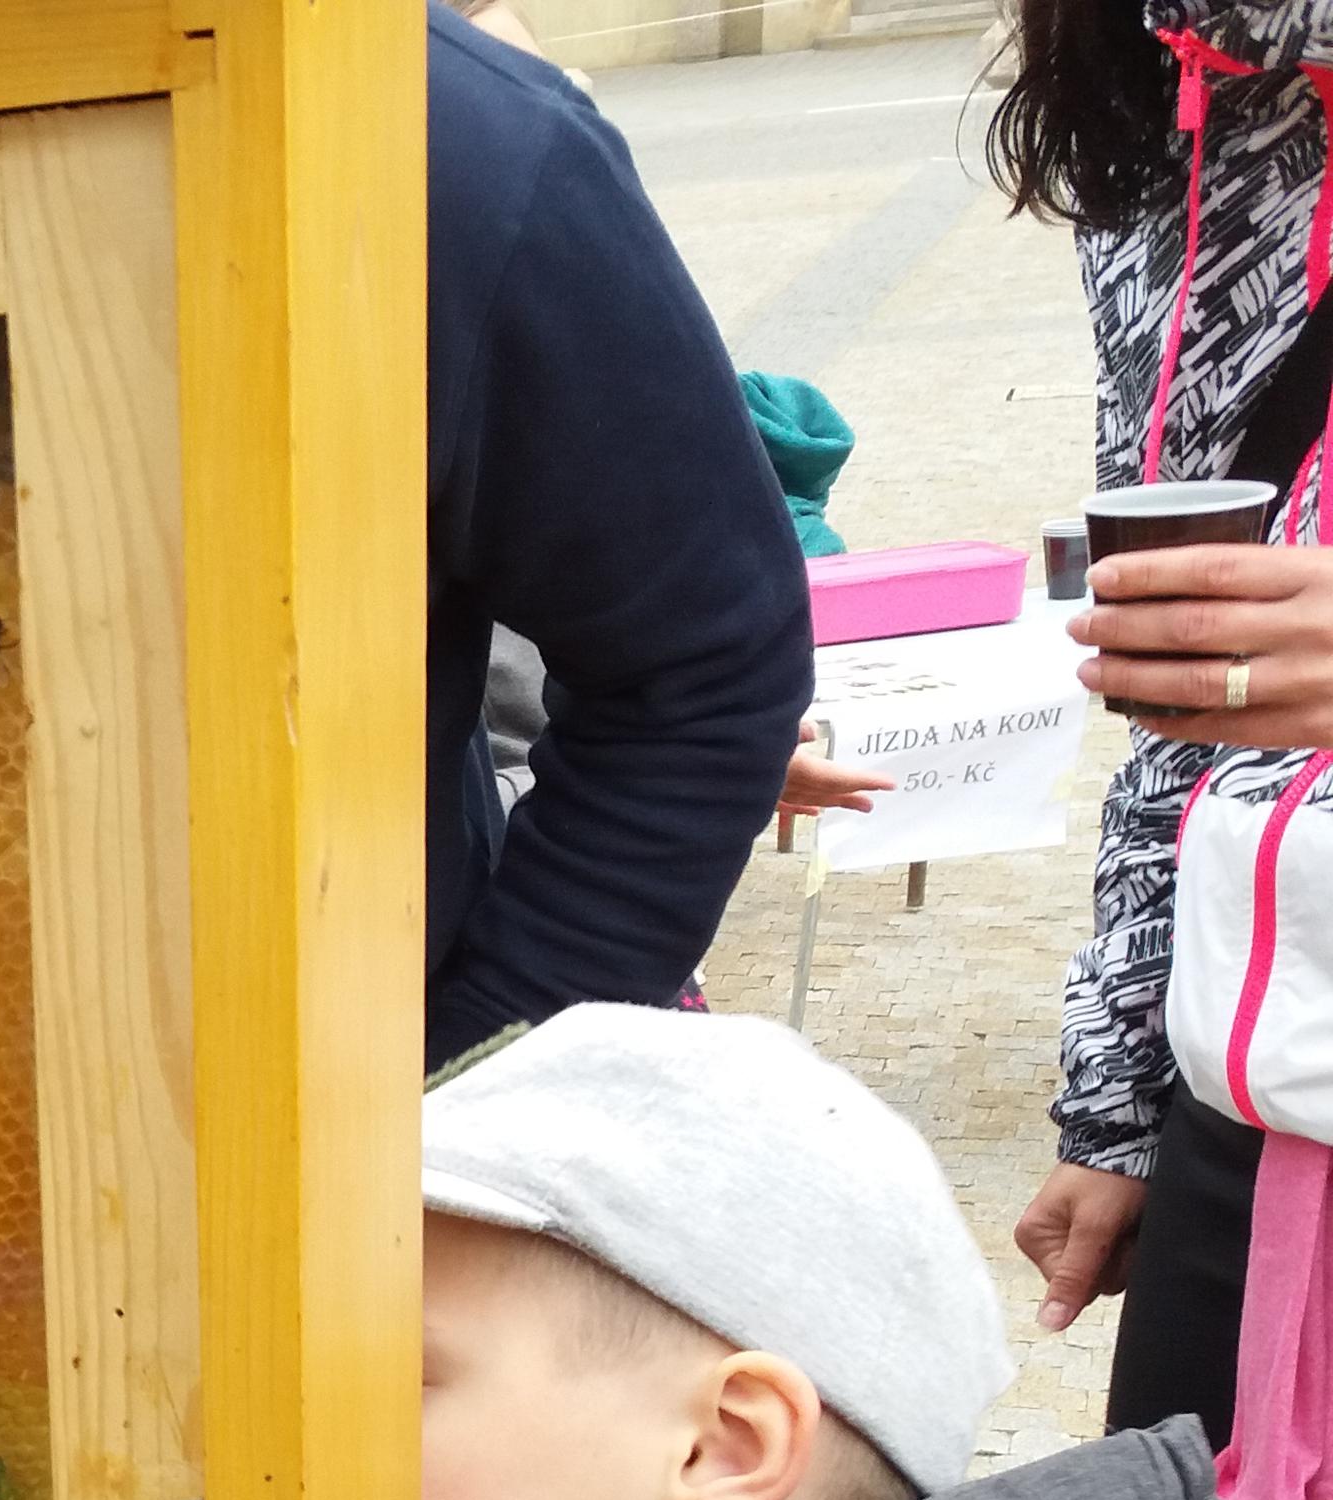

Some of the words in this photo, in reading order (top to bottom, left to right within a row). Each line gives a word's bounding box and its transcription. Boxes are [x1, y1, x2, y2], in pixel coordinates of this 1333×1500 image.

[1229, 231, 1304, 325] NIKE
[858, 725, 939, 756] JÍZDA
[949, 719, 986, 744] NA
[997, 707, 1062, 736] KONI
[904, 771, 955, 792] 50,-
[963, 760, 996, 785] Kč
[1125, 922, 1173, 965] NIK
